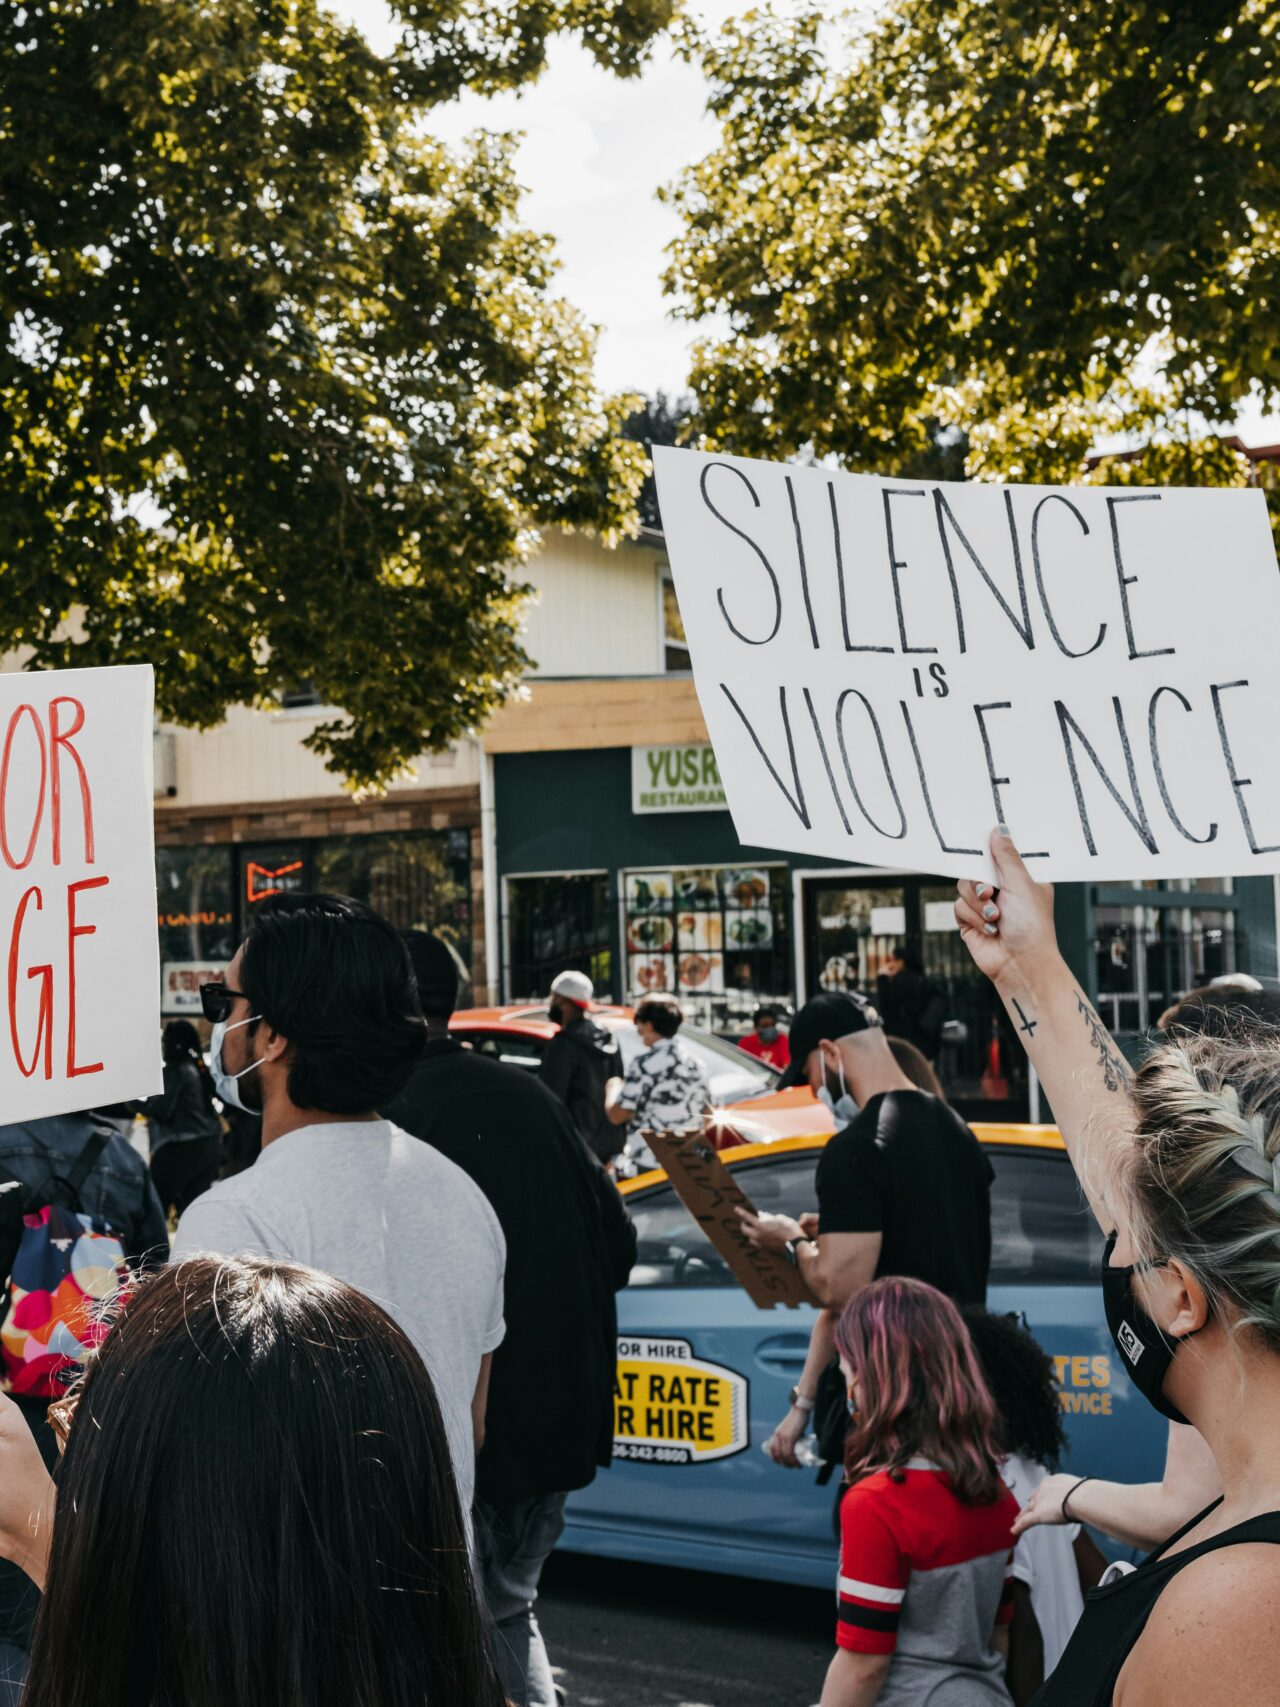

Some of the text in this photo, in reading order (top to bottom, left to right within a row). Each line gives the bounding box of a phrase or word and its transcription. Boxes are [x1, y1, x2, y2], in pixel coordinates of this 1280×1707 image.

[700, 462, 1176, 661] SILENCE
[913, 662, 949, 698] IS
[646, 747, 721, 788] YUSR
[720, 679, 1280, 858] VIOLENCE
[639, 790, 727, 807] RESTAURAN
[618, 1342, 688, 1360] OR HIRE
[1053, 1355, 1111, 1388] TES
[649, 1374, 720, 1407] RATE
[1059, 1391, 1113, 1415] RVICE
[646, 1407, 715, 1442] HIRE
